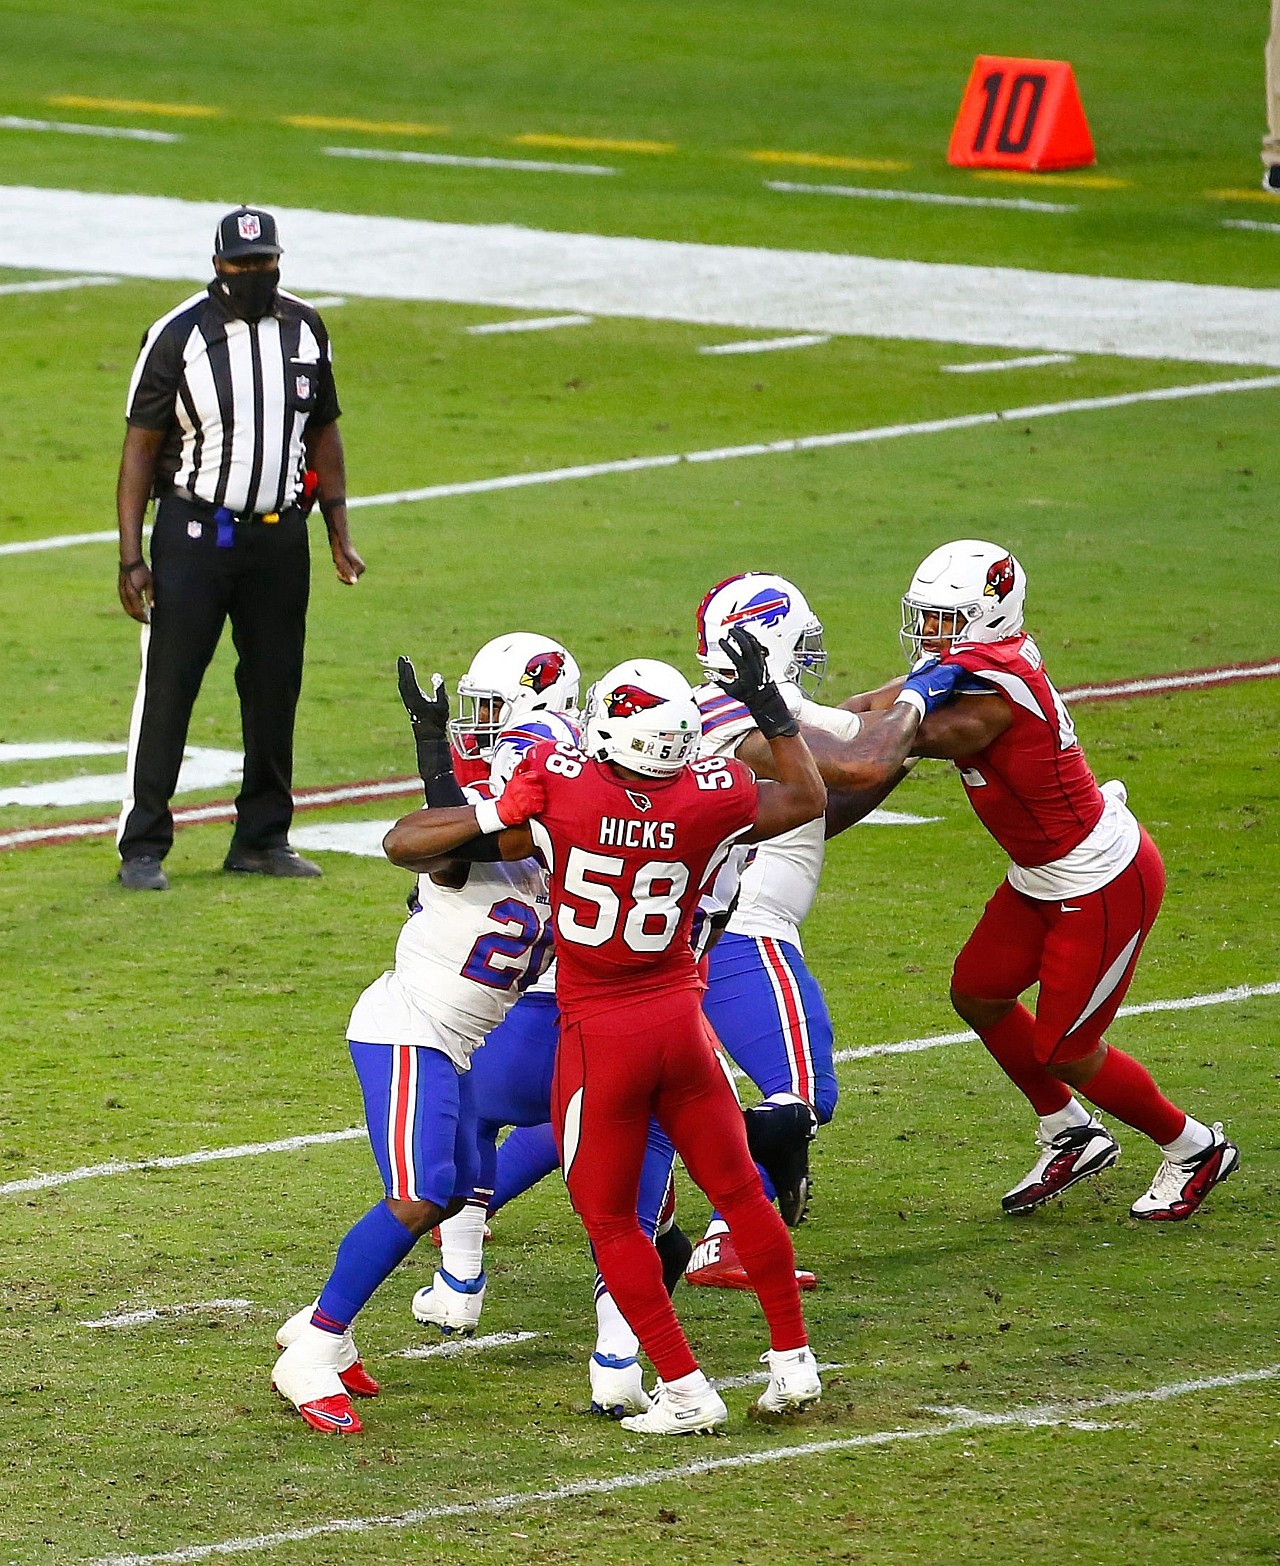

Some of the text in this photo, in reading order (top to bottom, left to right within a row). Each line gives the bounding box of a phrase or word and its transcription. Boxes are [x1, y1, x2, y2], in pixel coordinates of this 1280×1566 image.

[973, 72, 1047, 153] 10
[599, 816, 676, 850] HICKS
[556, 846, 691, 953] 58
[685, 1237, 722, 1274] NIKE
